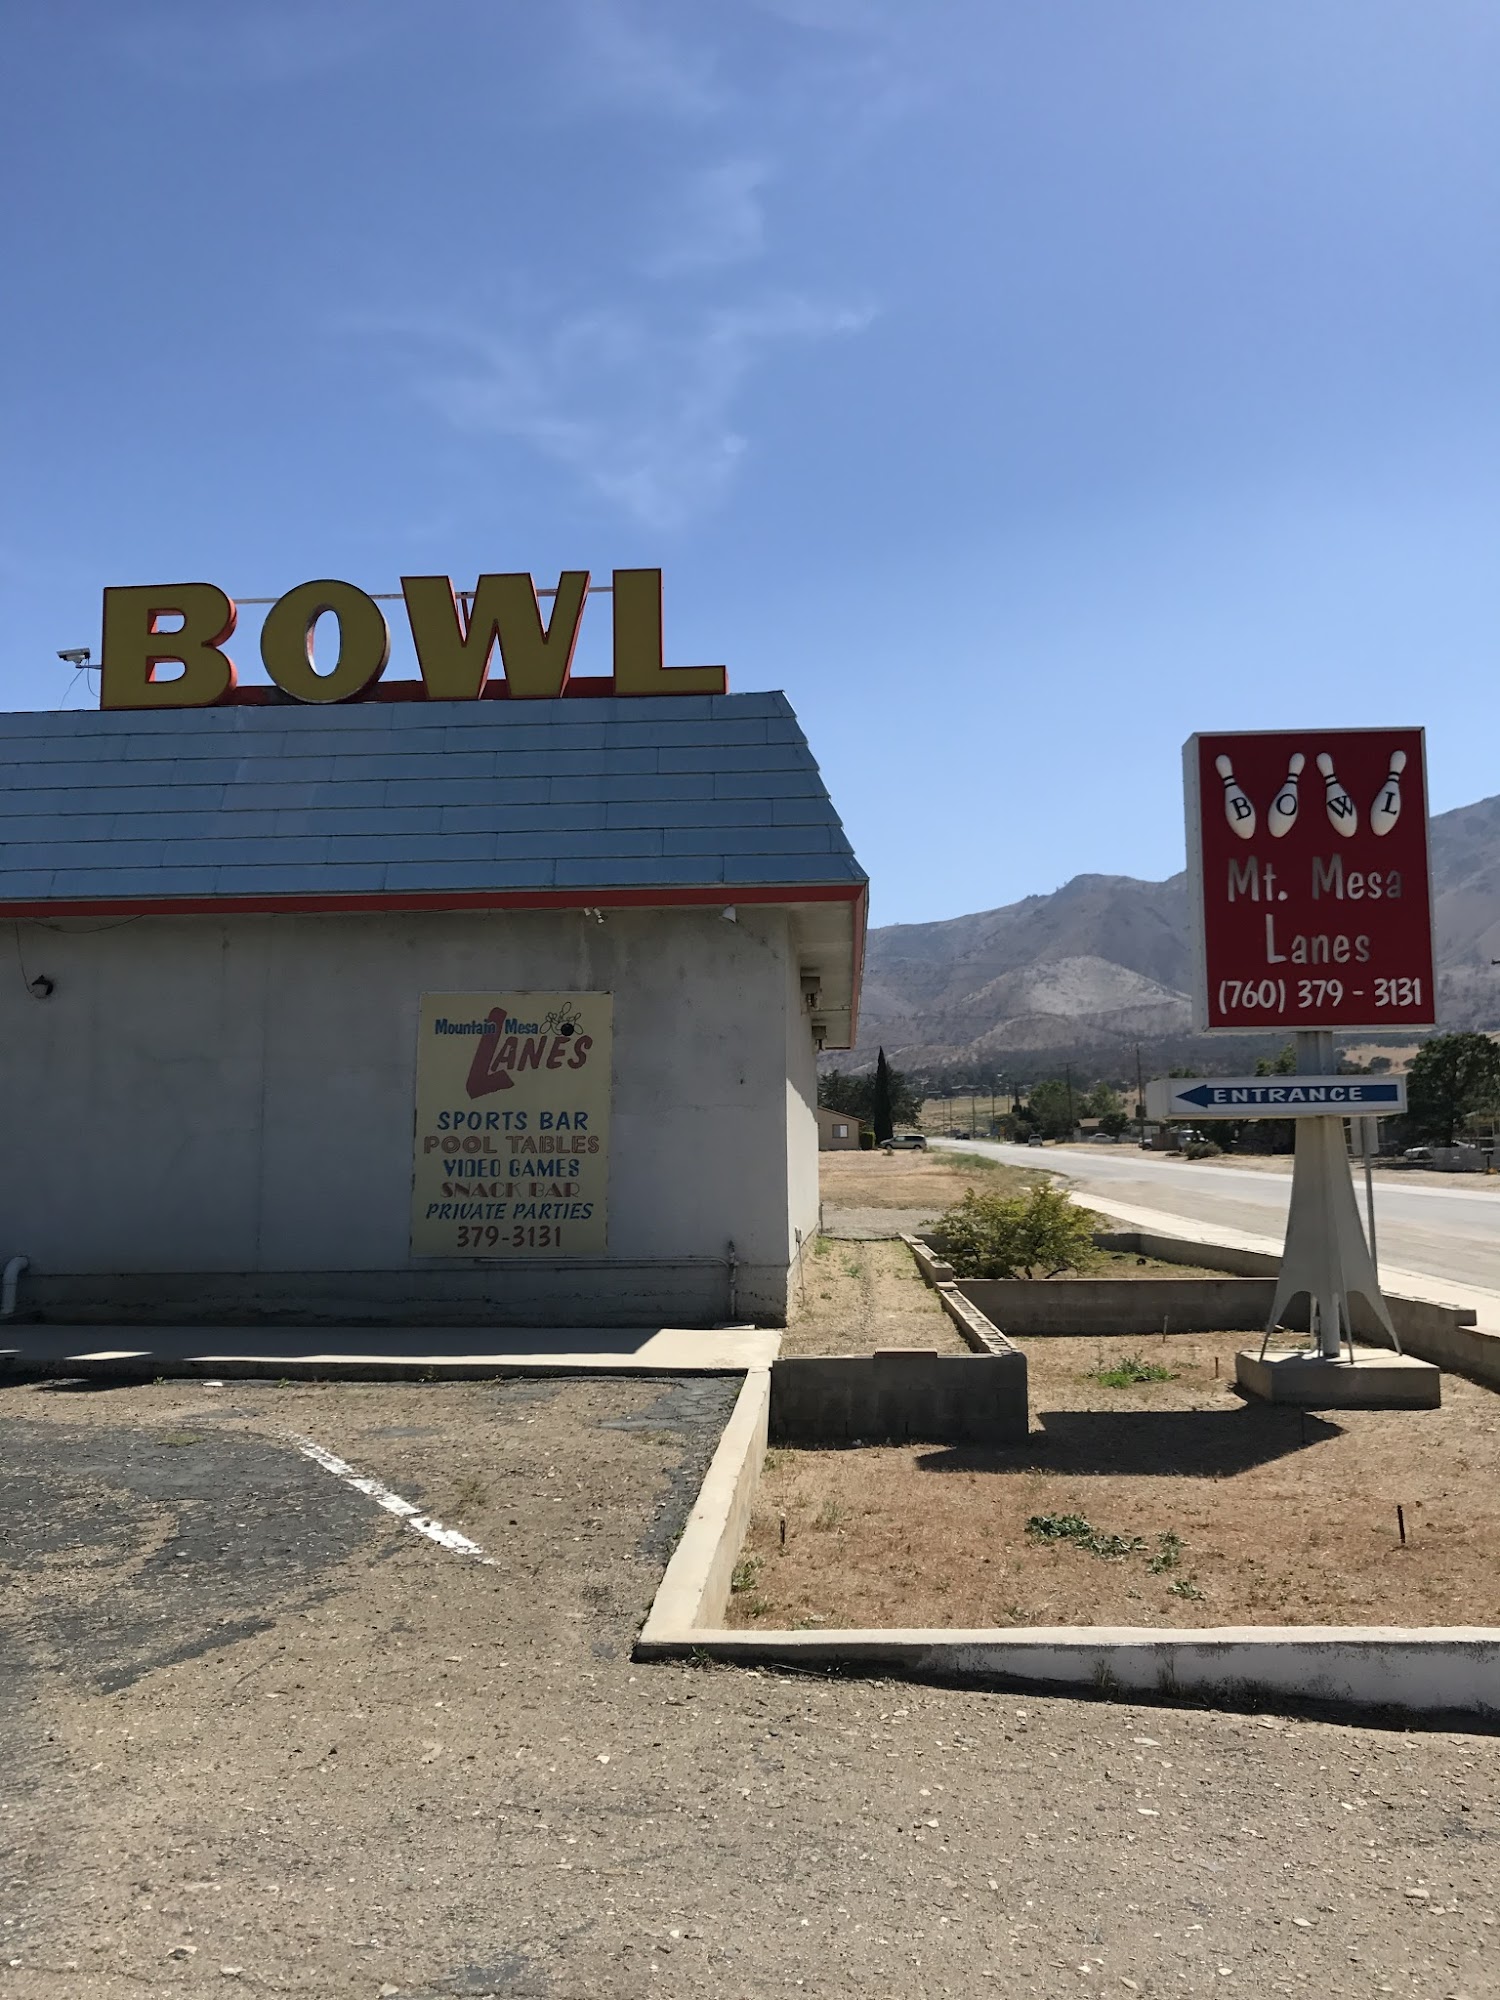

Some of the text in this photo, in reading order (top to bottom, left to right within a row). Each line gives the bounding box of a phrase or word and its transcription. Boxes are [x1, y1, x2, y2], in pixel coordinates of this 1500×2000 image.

[101, 568, 728, 709] BOWL
[1230, 791, 1398, 820] BOWL
[1228, 853, 1401, 902] Mt. Mesa
[1265, 913, 1371, 964] Lanes
[1218, 979, 1286, 1014] (760)
[1298, 980, 1344, 1008] 379
[1374, 977, 1422, 1007] 3131
[435, 1016, 539, 1035] Mountain Mesa
[465, 1006, 593, 1100] LANES
[1213, 1087, 1363, 1103] ENTRANCE
[437, 1112, 589, 1131] SPORTS BAR
[424, 1136, 600, 1154] POOL TABLES
[443, 1159, 580, 1177] VIDEO GAMES
[440, 1182, 580, 1198] SNACK BAR
[426, 1203, 594, 1219] PRIVATE PARTIES
[457, 1226, 561, 1248] 379-3131
